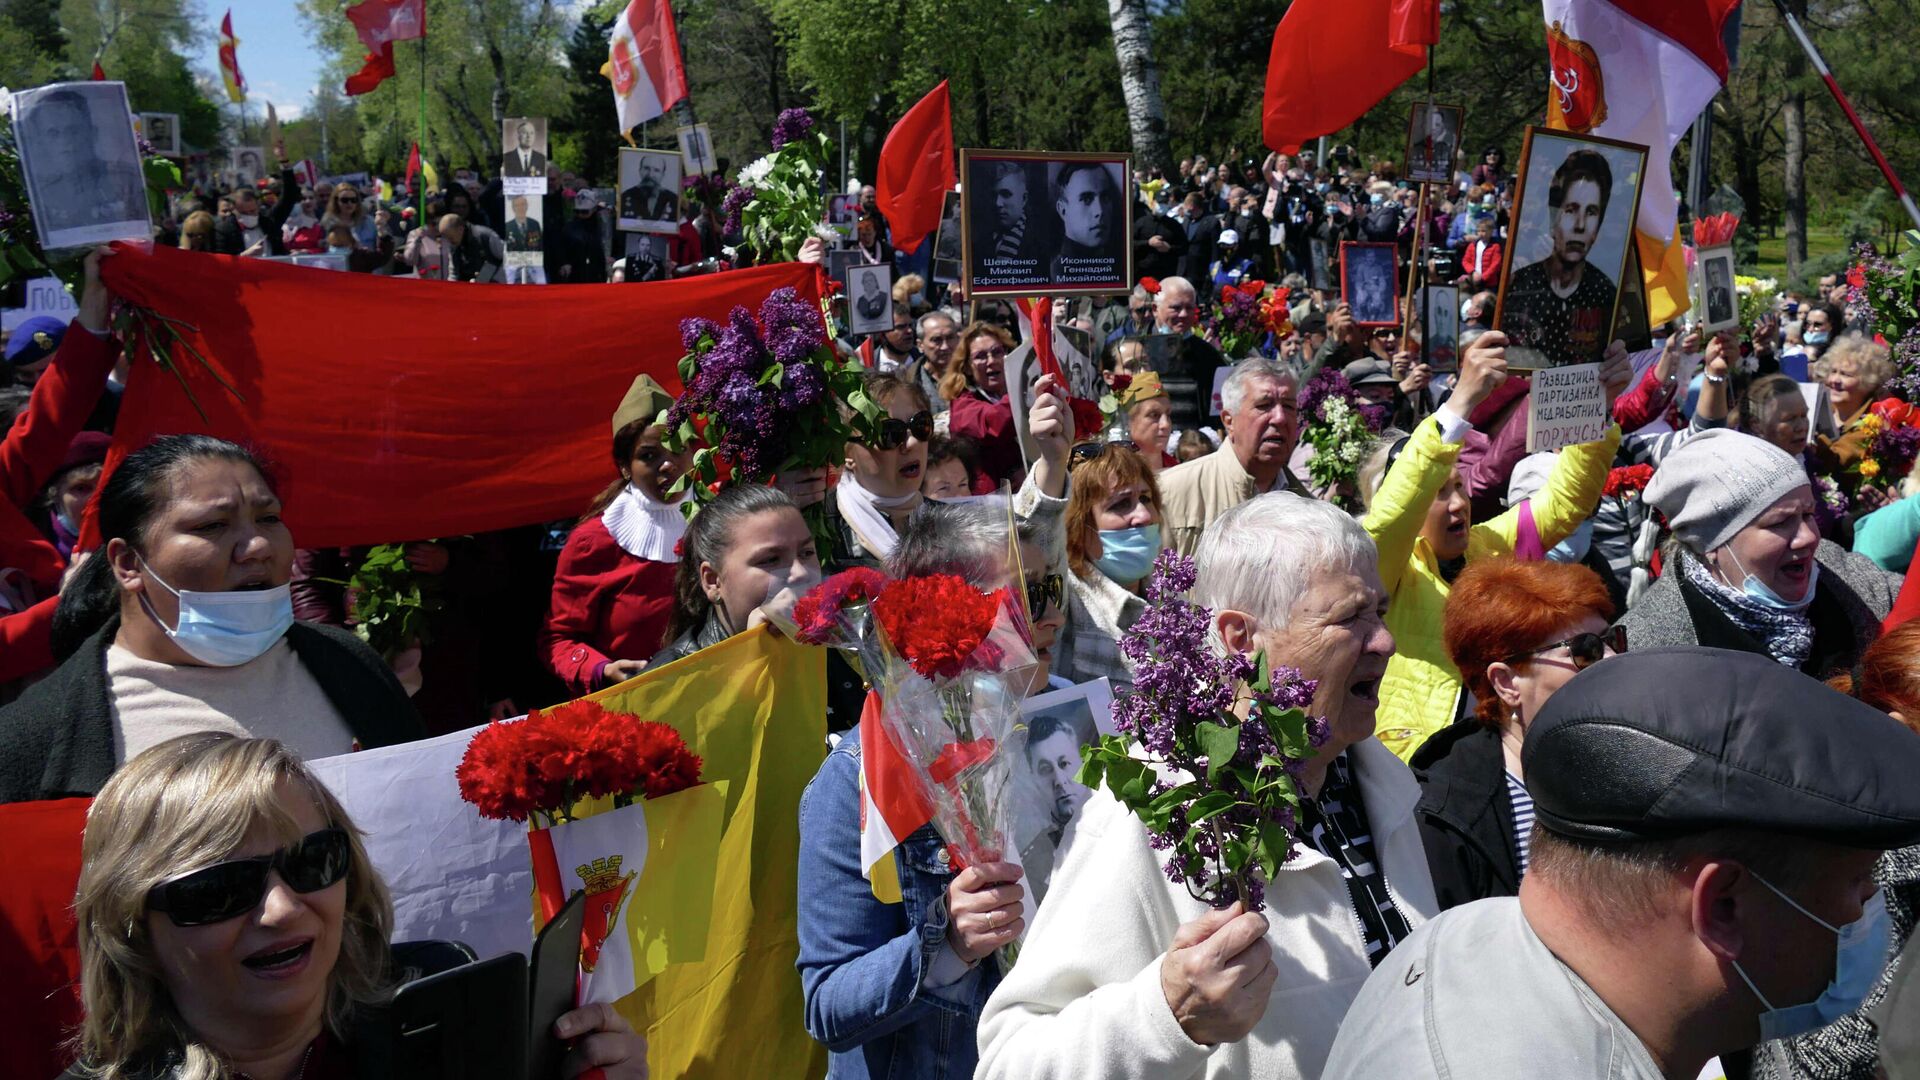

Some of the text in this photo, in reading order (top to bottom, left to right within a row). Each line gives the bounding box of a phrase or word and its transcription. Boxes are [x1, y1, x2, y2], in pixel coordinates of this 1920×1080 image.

[984, 258, 1038, 266] Шевченко
[1060, 257, 1115, 265] Иконников
[990, 267, 1032, 275] Михаил
[1063, 265, 1112, 274] Геннадий
[973, 277, 1049, 286] Ефстафьевич
[1056, 275, 1120, 283] Михайлович
[31, 286, 71, 311] ПОБ
[1538, 385, 1600, 405] ПАРТИЗАНКА
[1535, 421, 1604, 449] ГОРЖУСЬ!
